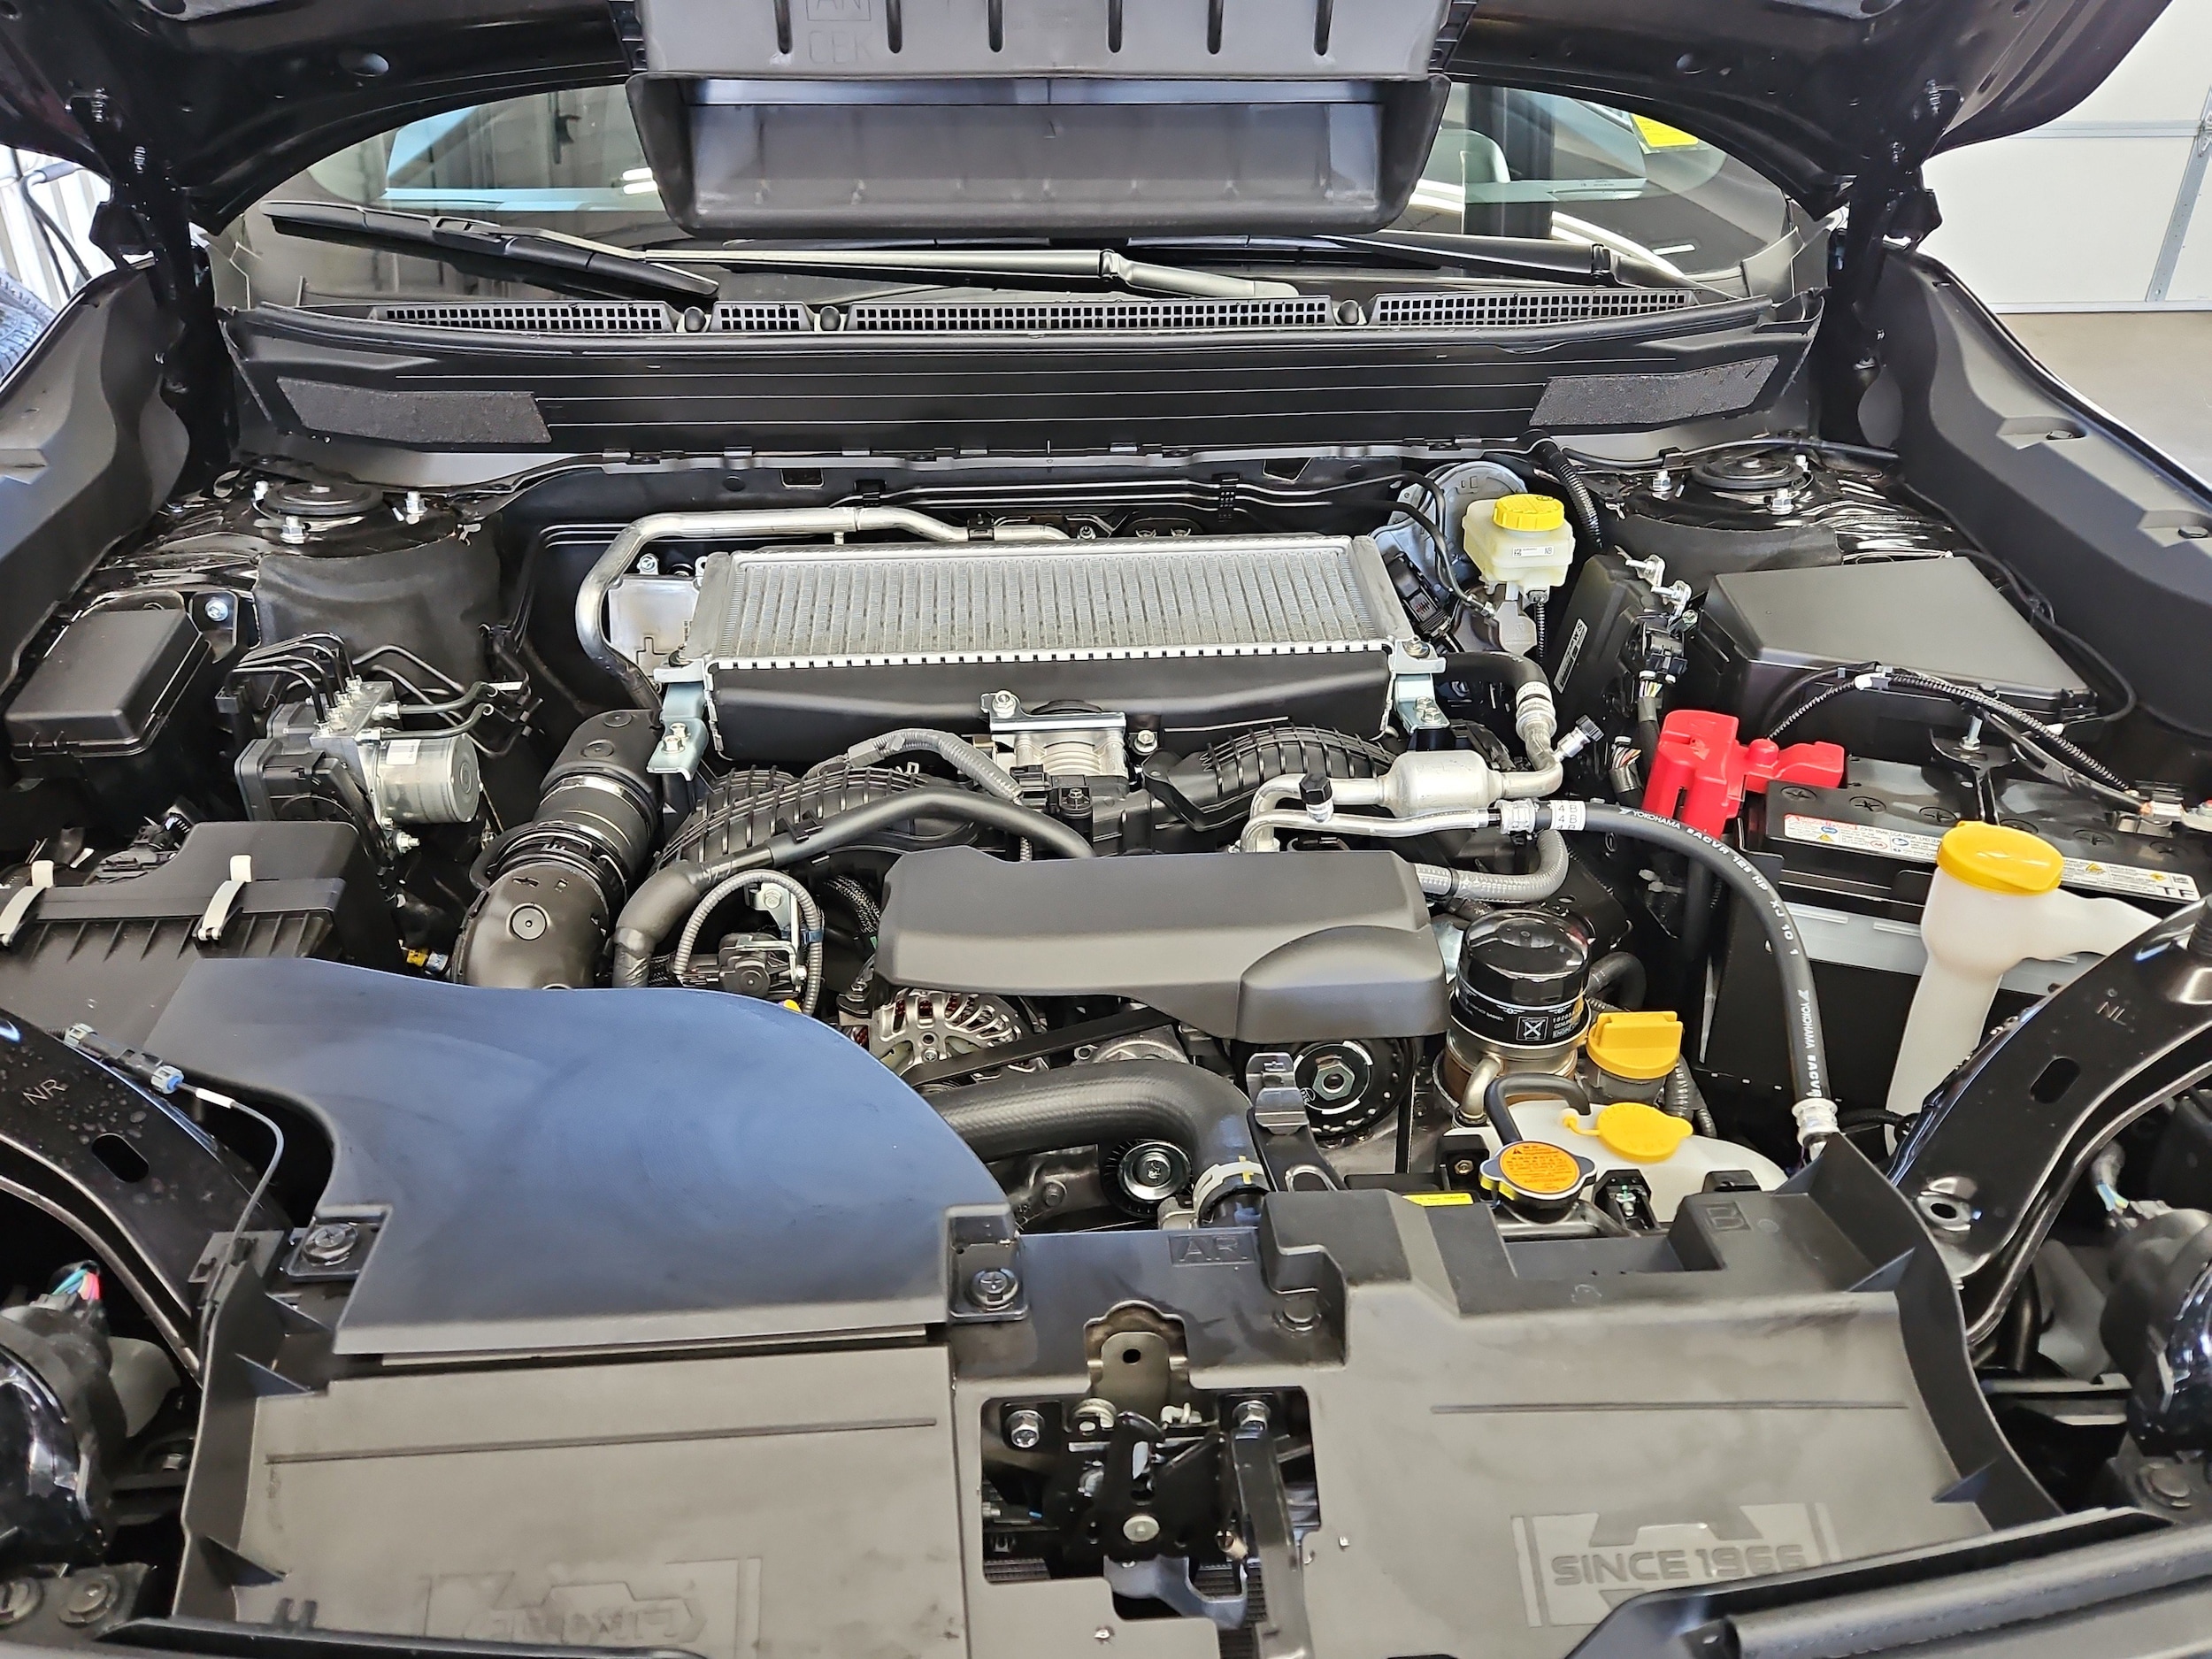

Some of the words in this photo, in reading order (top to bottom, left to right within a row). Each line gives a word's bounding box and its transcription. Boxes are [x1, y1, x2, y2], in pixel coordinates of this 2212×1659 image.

[1632, 809, 1681, 830] YOKOHAMA
[1800, 1002, 1816, 1049] YOKOHAMA
[22, 1079, 66, 1106] NR
[1179, 1236, 1248, 1262] AR
[1550, 1550, 1691, 1586] SINCE
[1695, 1545, 1808, 1578] 1966
